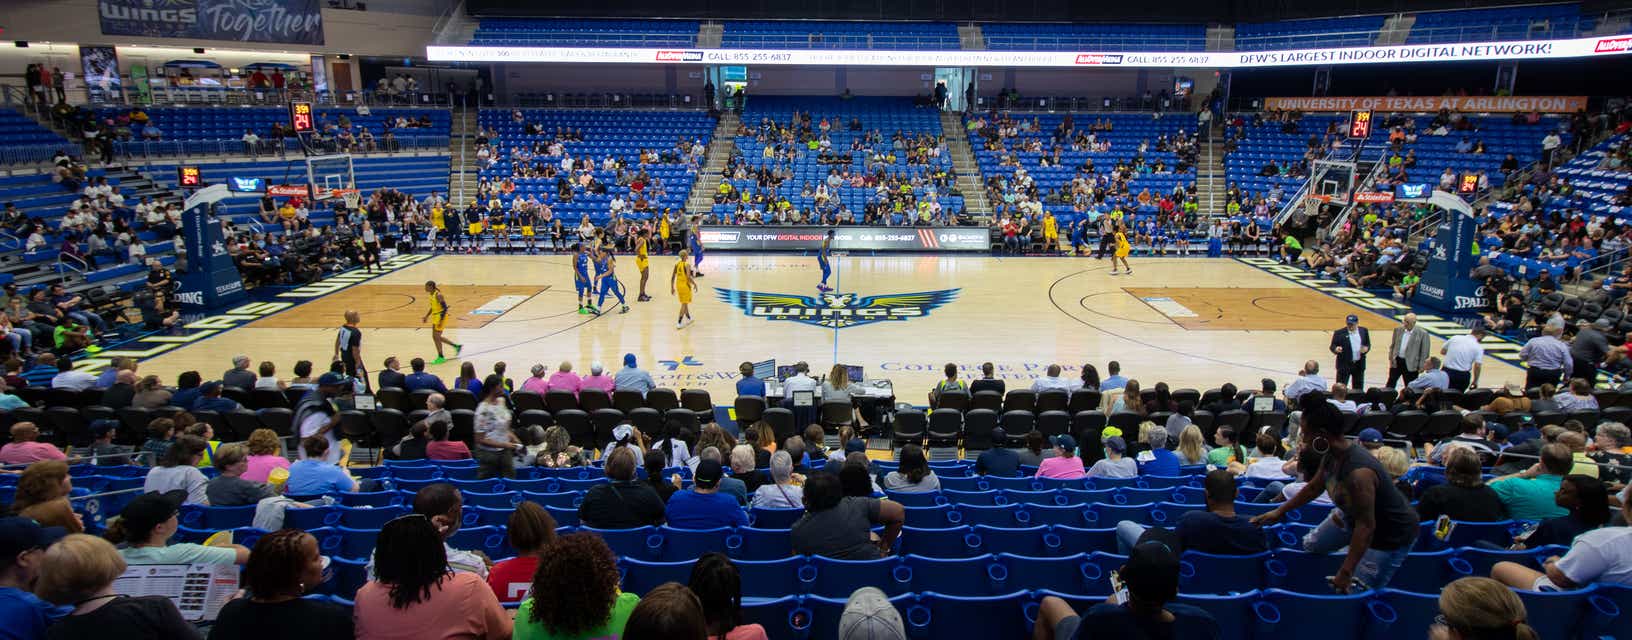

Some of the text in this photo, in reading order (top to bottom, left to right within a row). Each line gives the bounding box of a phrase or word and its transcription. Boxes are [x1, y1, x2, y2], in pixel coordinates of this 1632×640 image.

[101, 3, 197, 23] WINGS
[207, 5, 321, 40] Together
[1240, 43, 1552, 64] DFW'S LARGEST INDOOR DIGITAL NETWORK!
[1278, 98, 1567, 110] UNIVERSITY OF TEXAS AT ARLINGTON
[296, 114, 310, 129] 24
[1353, 121, 1367, 136] 24
[752, 306, 922, 316] WINGS
